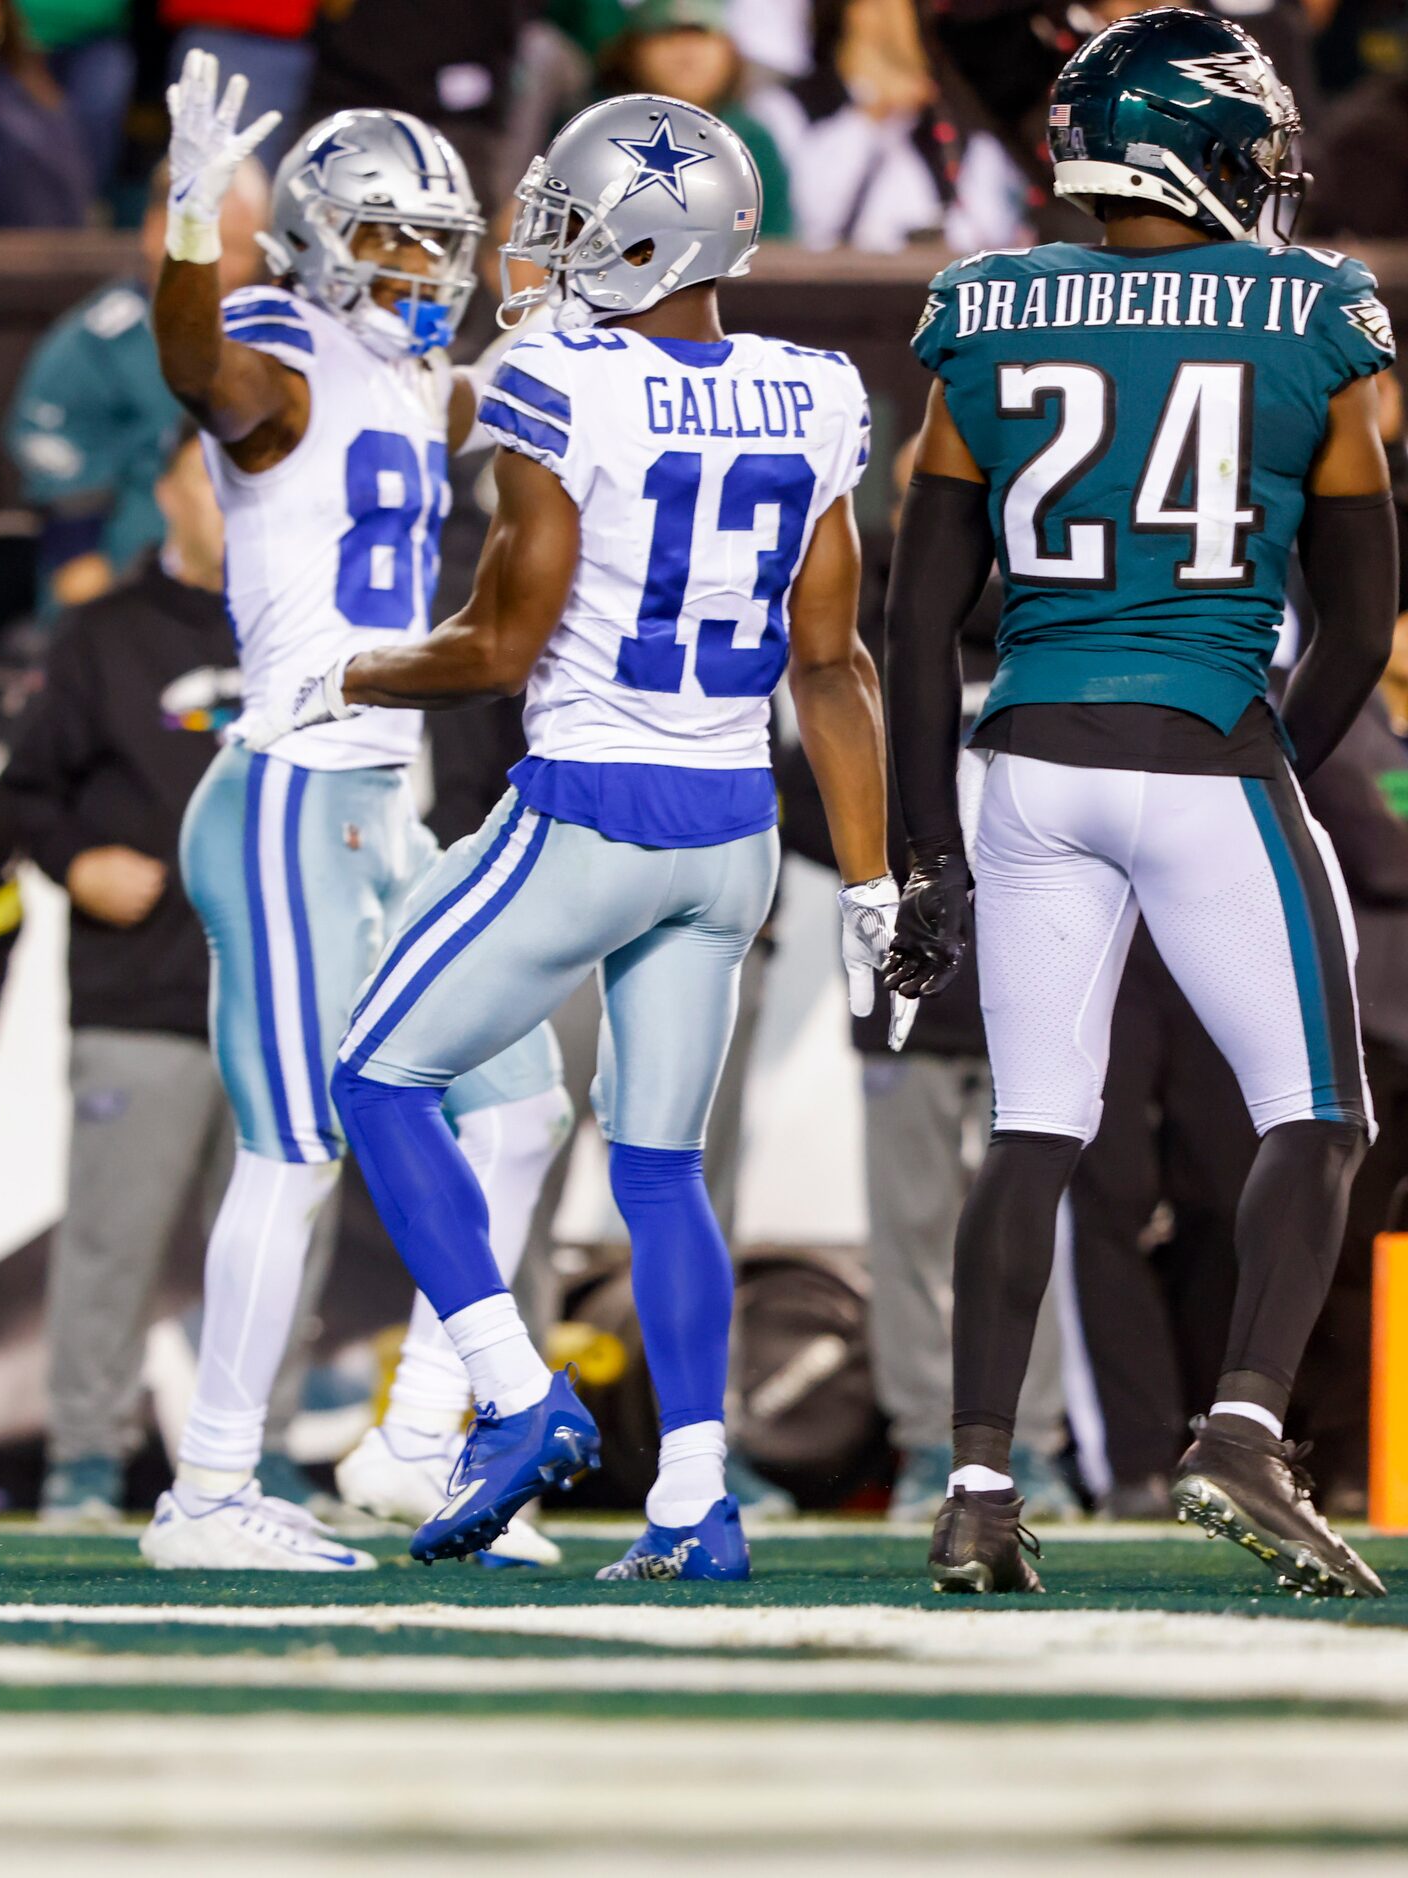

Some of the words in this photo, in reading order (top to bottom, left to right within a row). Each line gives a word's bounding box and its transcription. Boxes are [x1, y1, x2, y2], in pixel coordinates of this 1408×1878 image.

[955, 271, 1256, 339] BRADBERRY
[1263, 277, 1324, 337] IV
[645, 376, 814, 437] GALLUP
[996, 360, 1264, 590] 24
[614, 450, 817, 698] 13
